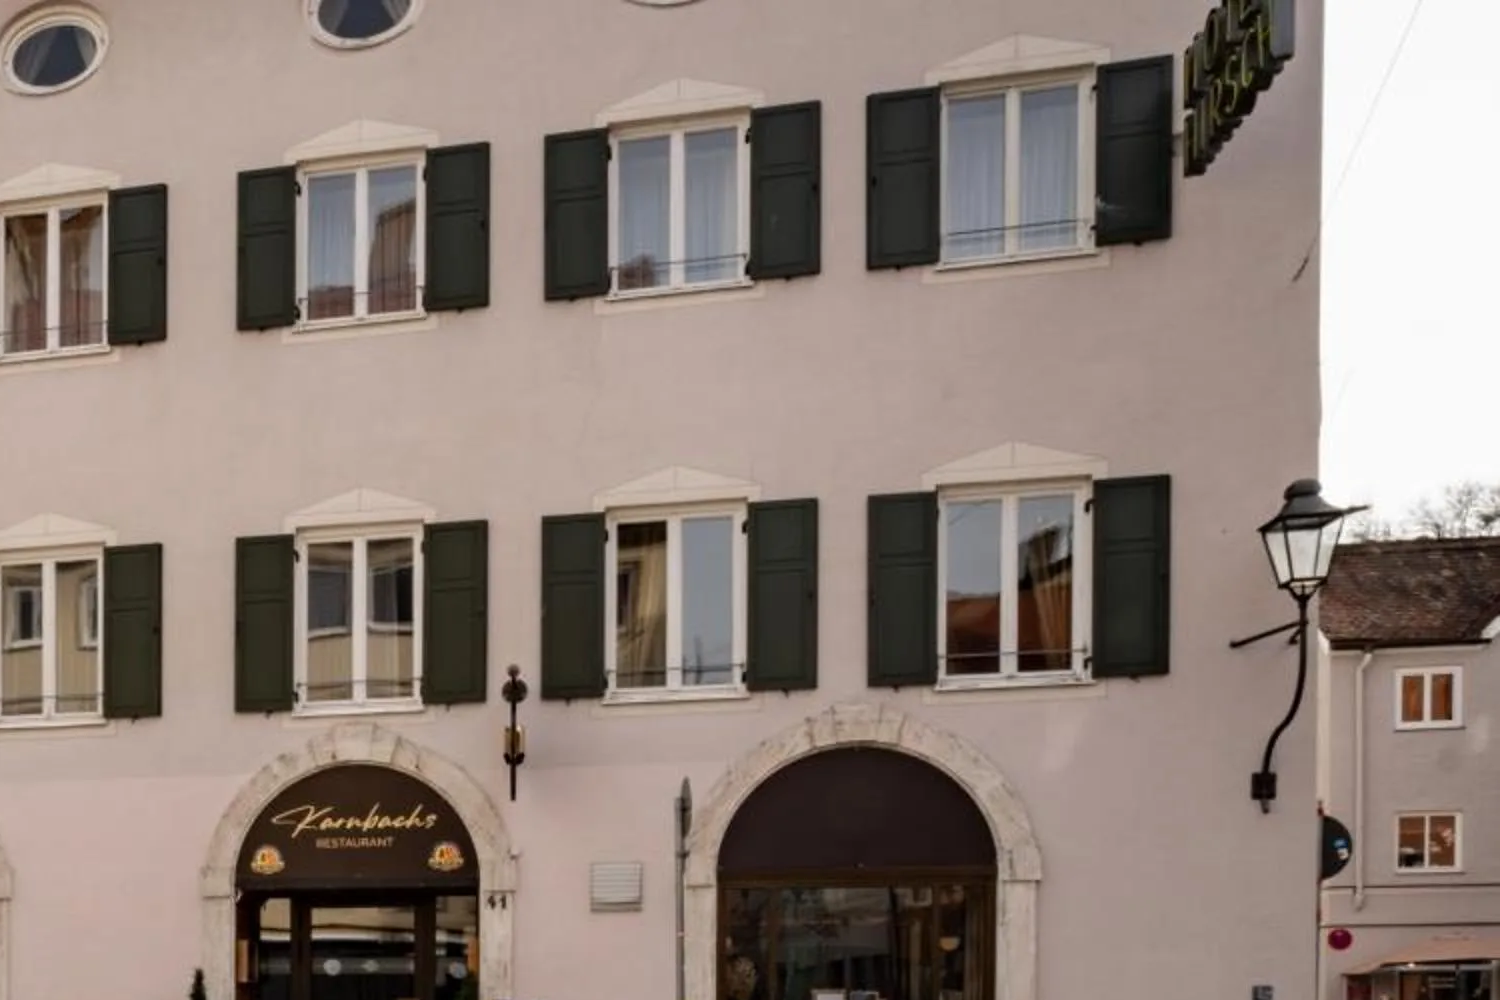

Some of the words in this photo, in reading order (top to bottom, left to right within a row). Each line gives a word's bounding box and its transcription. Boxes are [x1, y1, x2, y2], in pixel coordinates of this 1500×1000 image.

[271, 801, 438, 839] Karnbachs
[315, 836, 395, 849] RESTAURANT
[487, 894, 507, 909] 41
